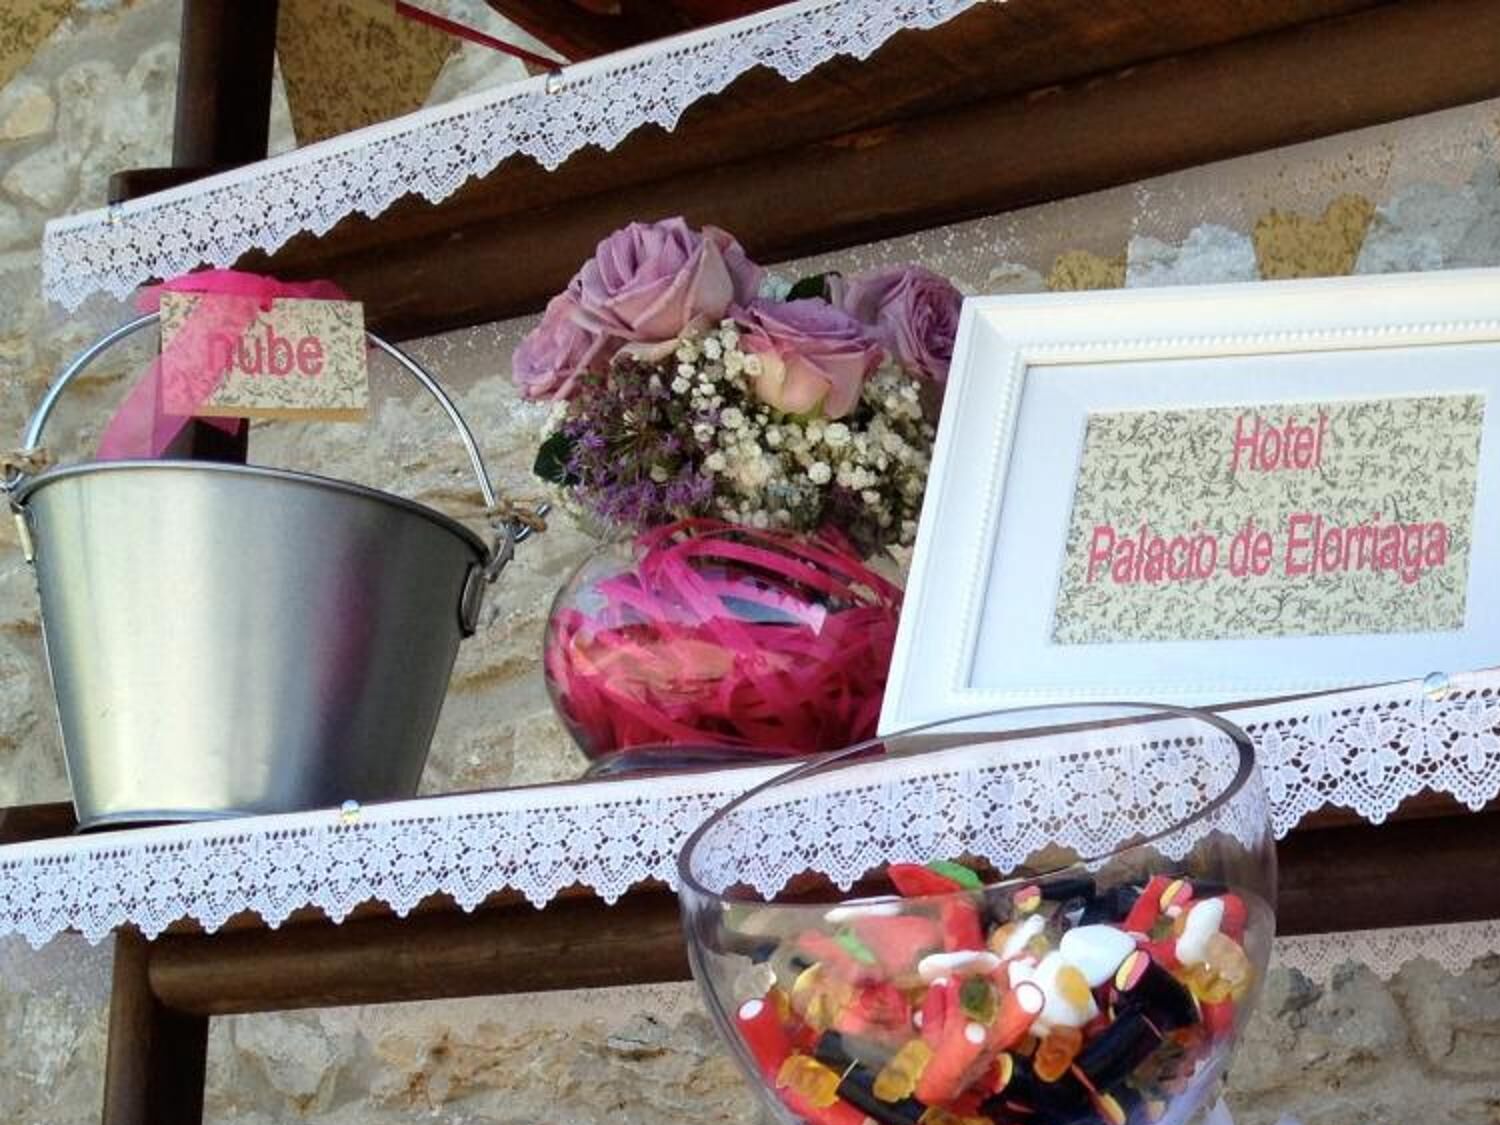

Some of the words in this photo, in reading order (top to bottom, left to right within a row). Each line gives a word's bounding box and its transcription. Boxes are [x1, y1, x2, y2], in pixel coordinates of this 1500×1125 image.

[207, 324, 324, 375] nube
[1230, 414, 1329, 472] Hotel
[1087, 520, 1219, 585] Palacio
[1228, 515, 1273, 579] de
[1284, 511, 1450, 586] Elorriaga
